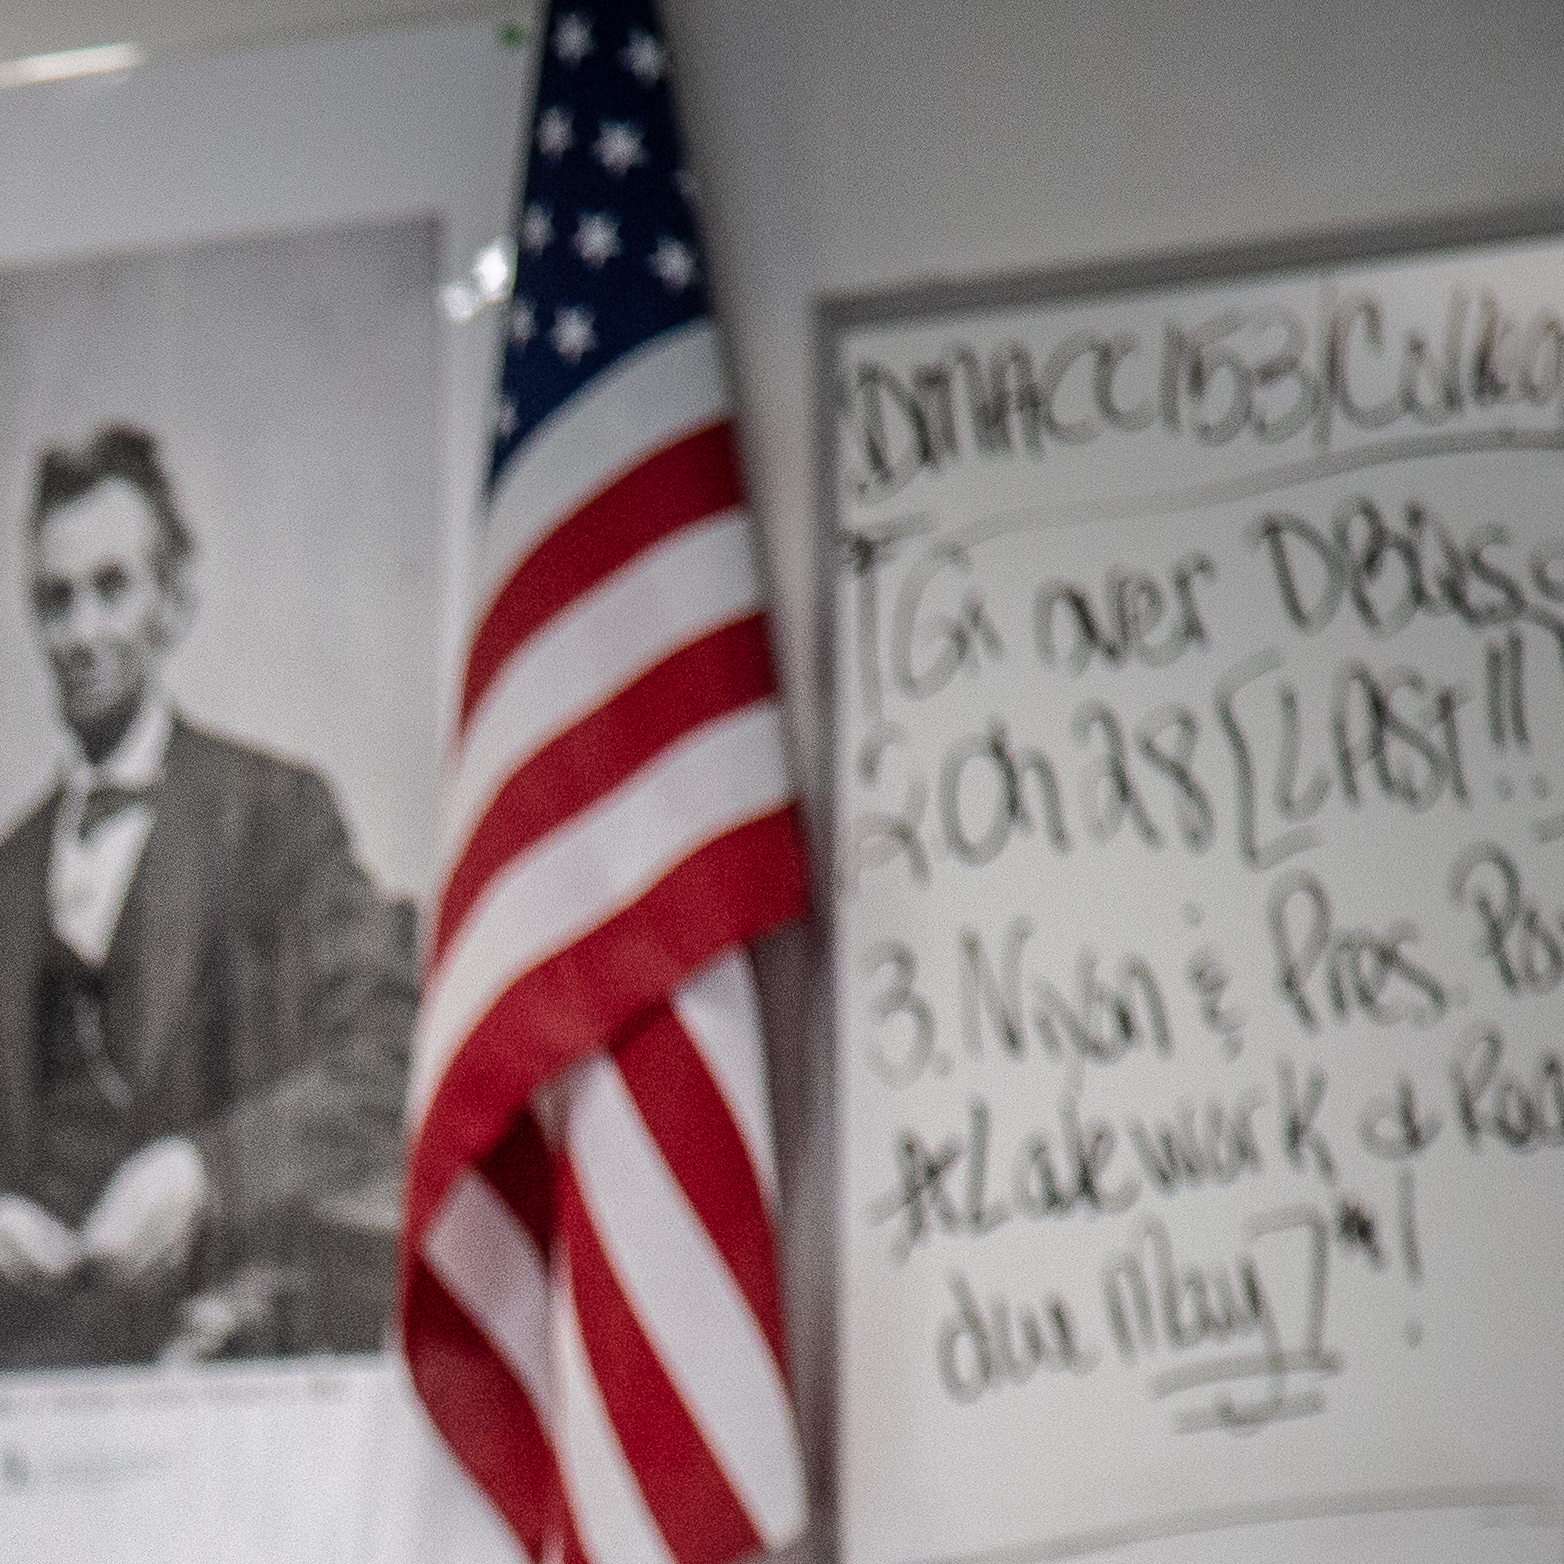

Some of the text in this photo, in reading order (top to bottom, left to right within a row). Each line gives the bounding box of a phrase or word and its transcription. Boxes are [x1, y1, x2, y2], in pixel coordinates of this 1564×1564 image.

[1029, 550, 1219, 670] over
[1071, 700, 1217, 856] 28
[957, 912, 1175, 1066] Nixon
[933, 1270, 1105, 1404] due
